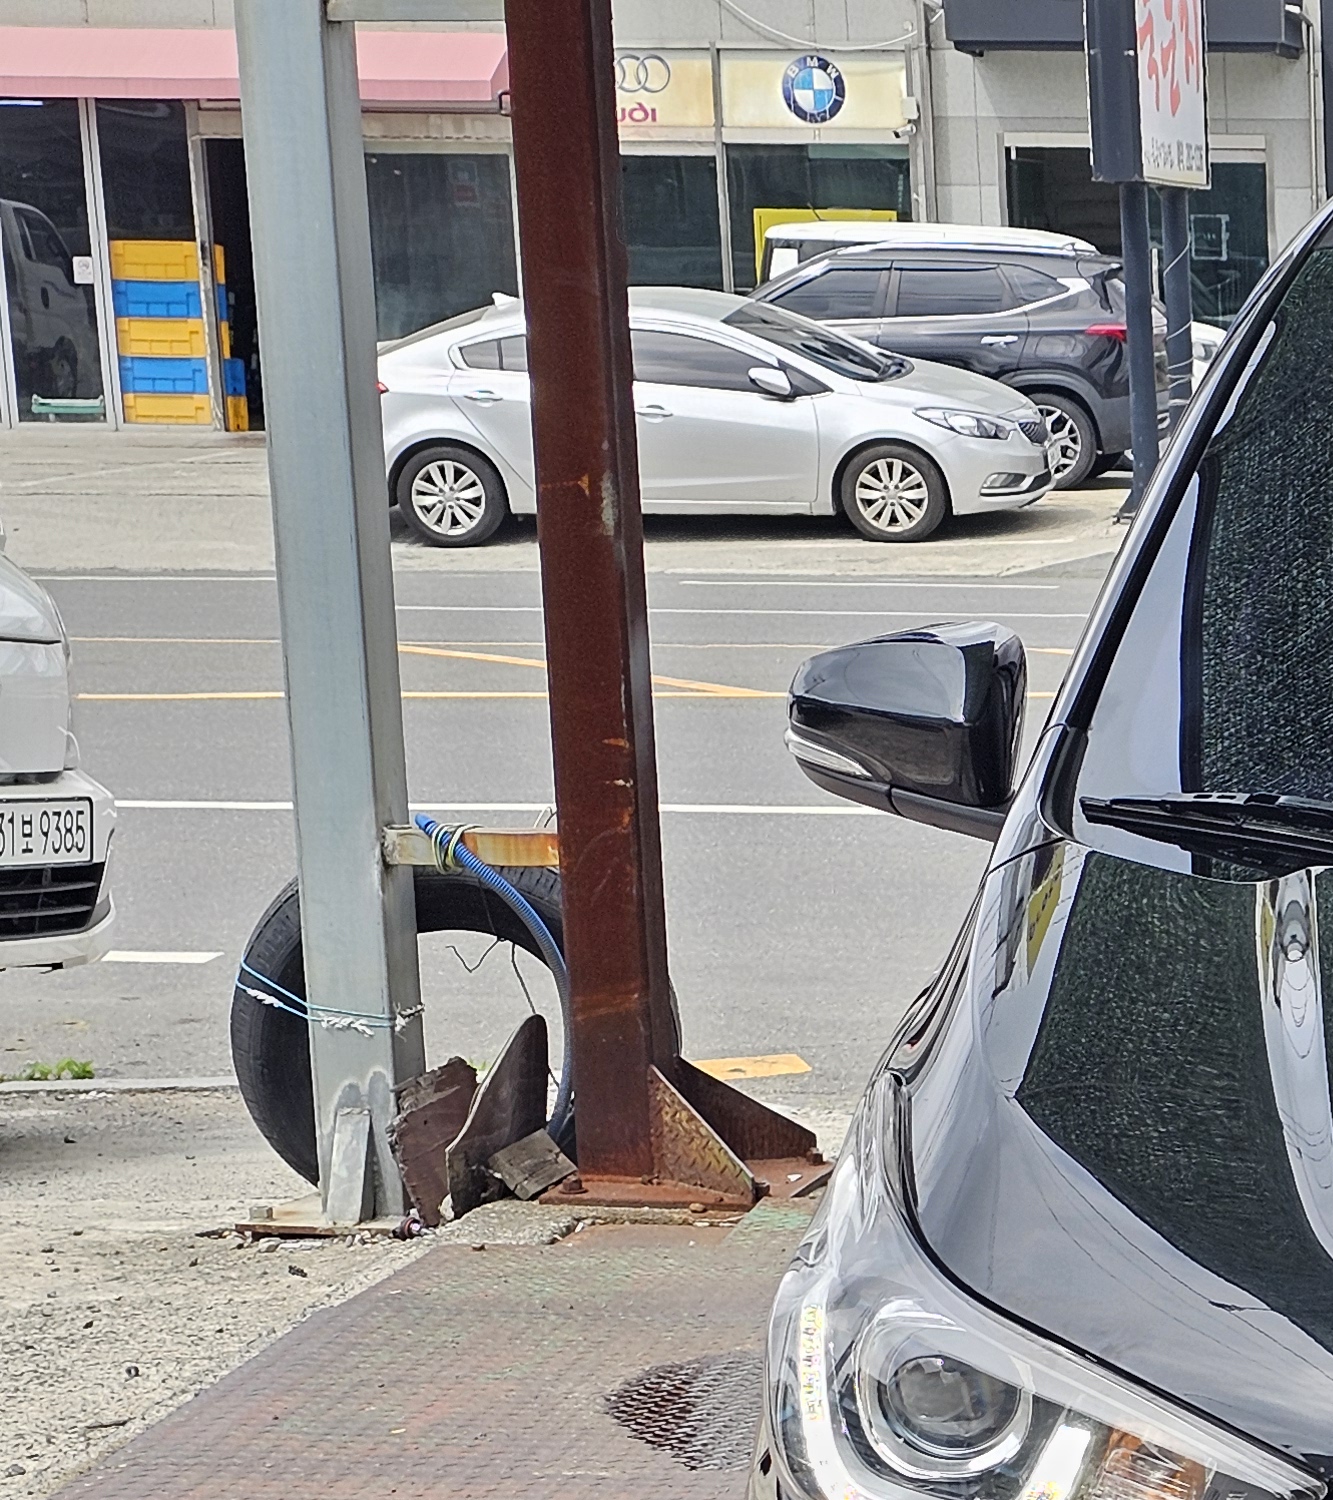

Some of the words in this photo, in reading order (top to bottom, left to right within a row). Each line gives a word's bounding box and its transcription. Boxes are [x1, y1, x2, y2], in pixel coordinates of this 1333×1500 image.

[786, 56, 839, 79] BMW
[617, 101, 657, 122] udi
[40, 810, 86, 855] 9385
